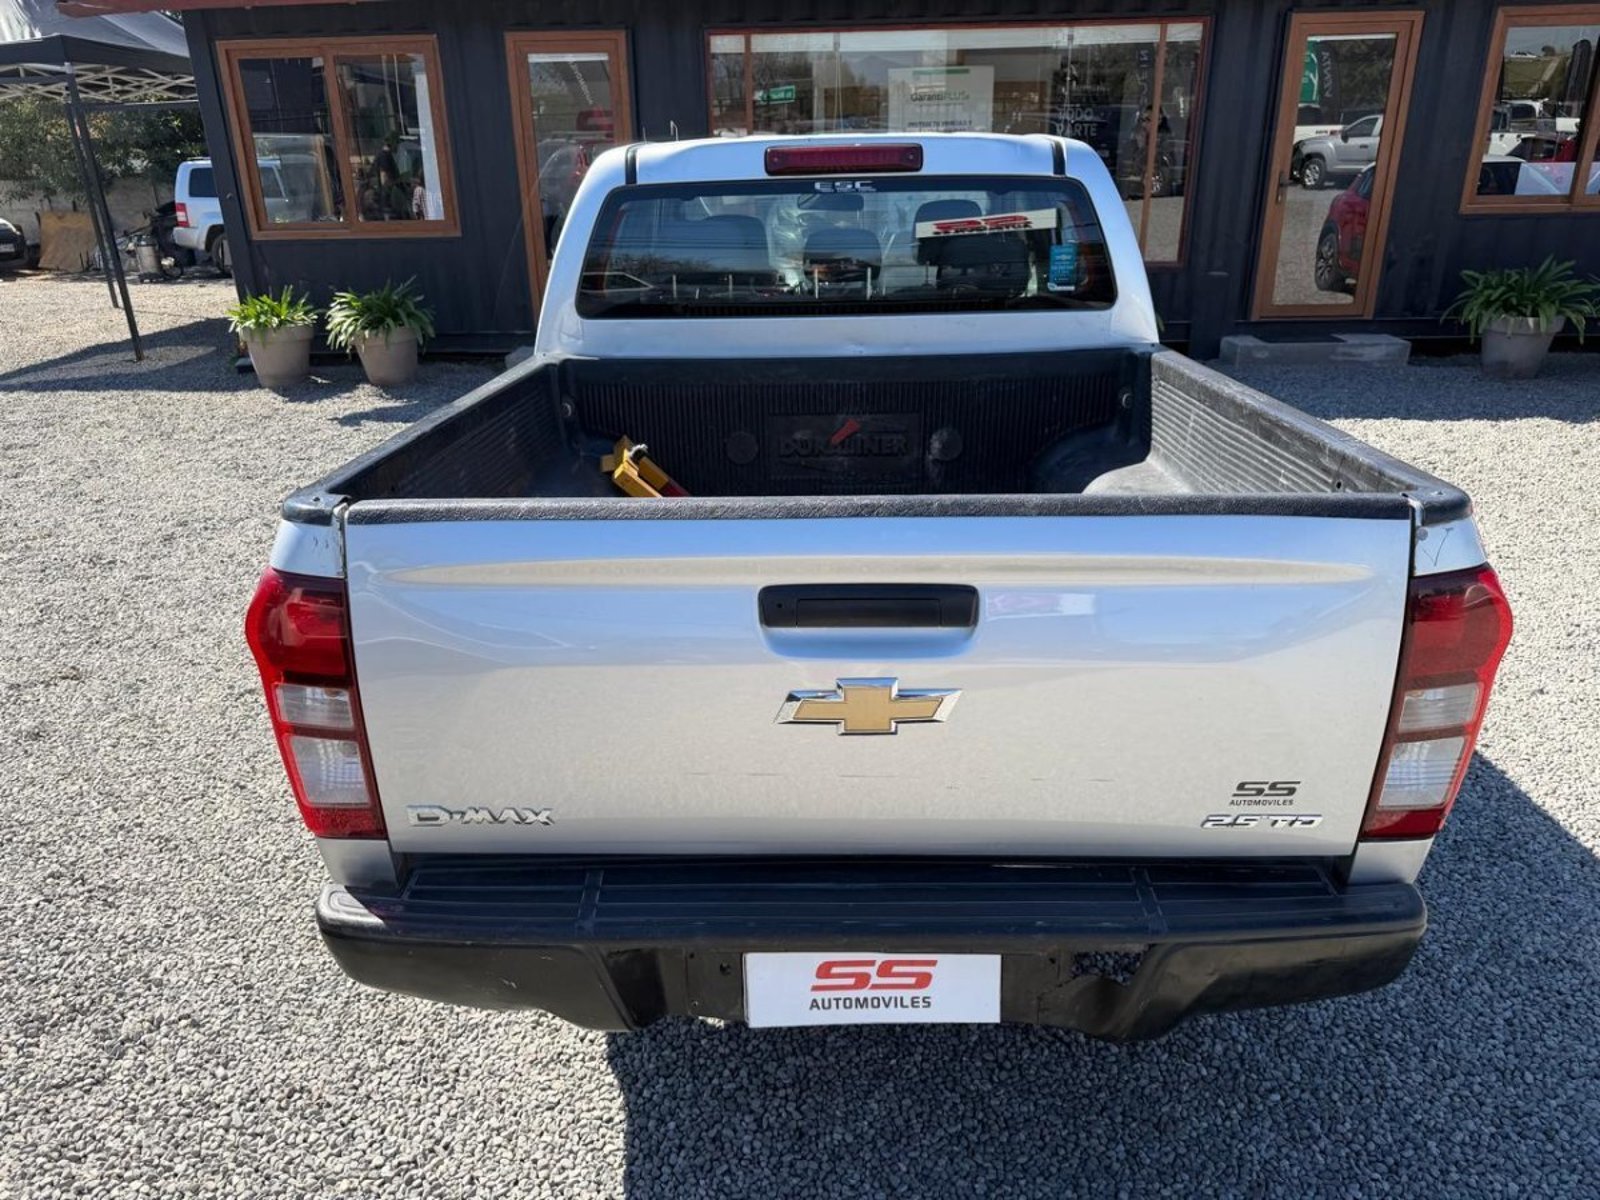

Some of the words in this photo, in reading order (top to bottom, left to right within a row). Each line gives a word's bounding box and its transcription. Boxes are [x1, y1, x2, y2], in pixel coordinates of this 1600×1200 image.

[1232, 781, 1301, 797] SS
[406, 804, 555, 827] D-MAX
[811, 960, 938, 991] SS
[809, 996, 932, 1011] AUTOMOVILES
